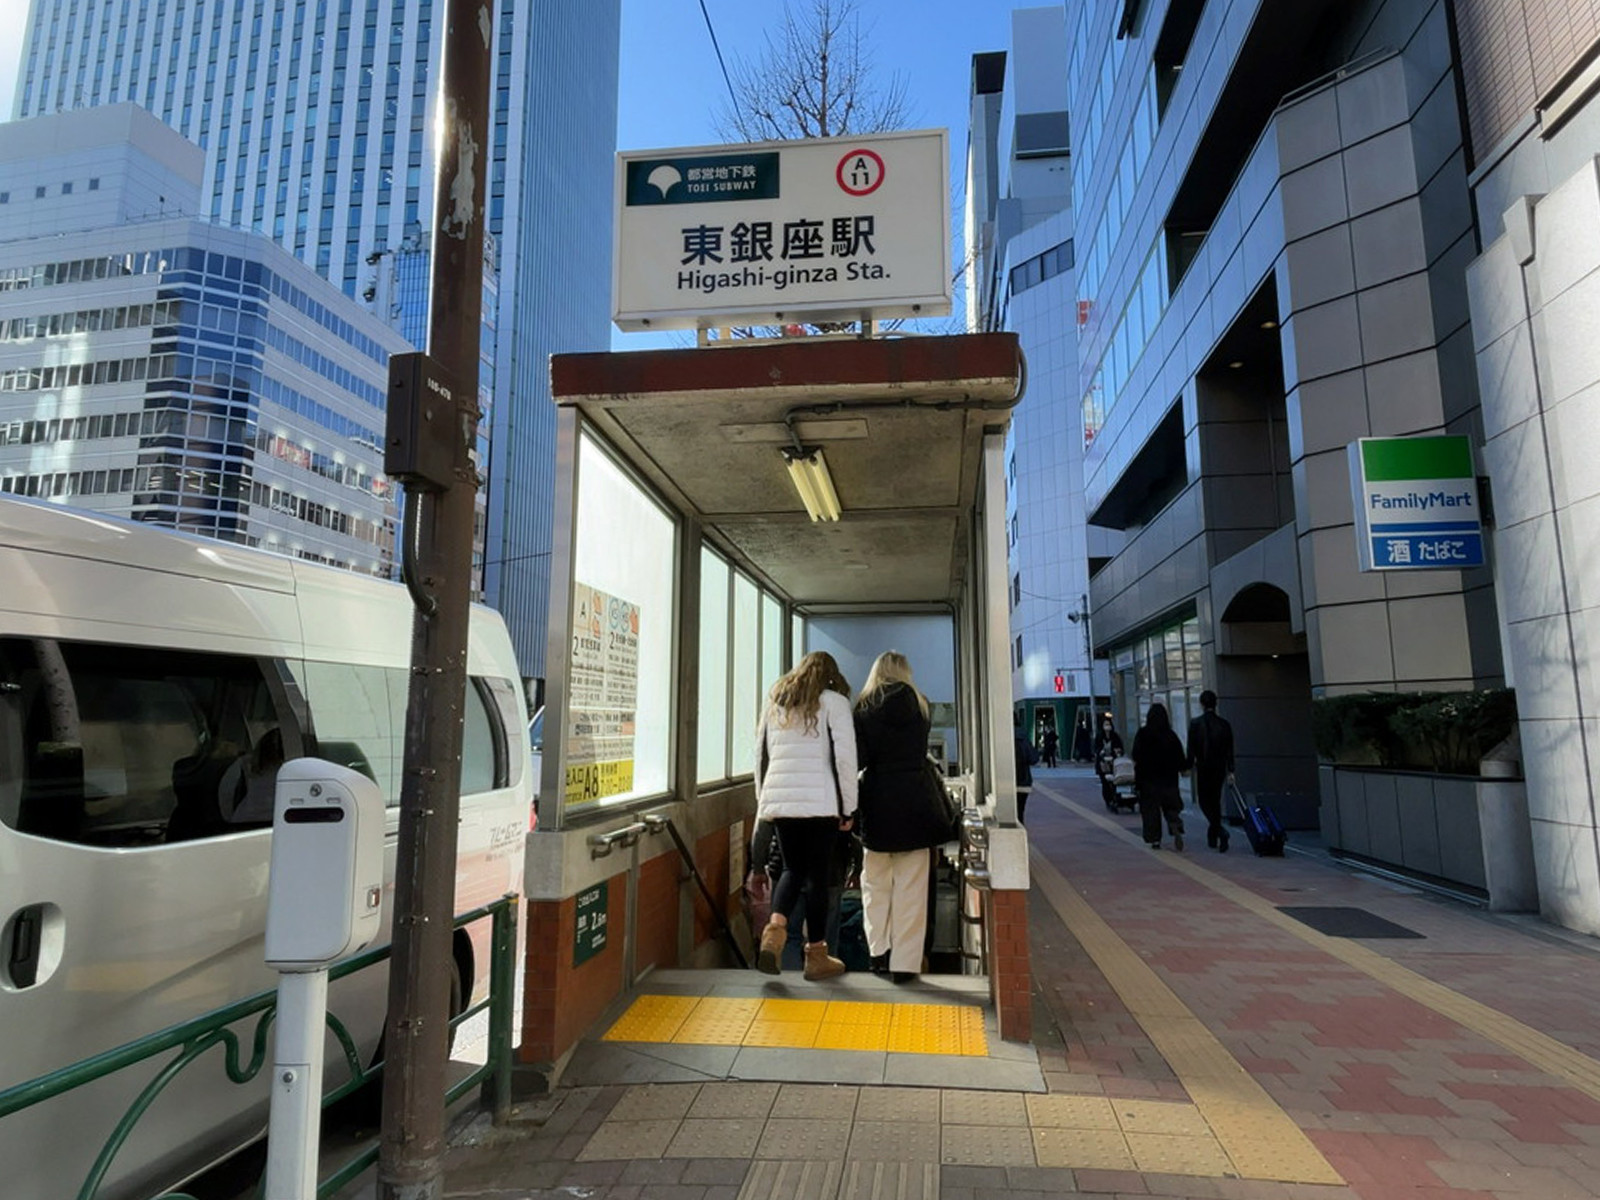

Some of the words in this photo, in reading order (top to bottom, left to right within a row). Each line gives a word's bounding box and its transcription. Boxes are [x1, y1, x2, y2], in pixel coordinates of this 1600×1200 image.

[855, 157, 867, 170] A
[687, 165, 757, 181] 都営地下鉄
[851, 171, 869, 186] 11
[687, 183, 710, 193] TOEI
[713, 180, 757, 193] SUBWAY
[681, 215, 876, 266] 東銀座駅
[677, 265, 838, 293] Higashi-ginza
[846, 261, 891, 281] Sta.
[1370, 491, 1472, 510] FamilyMart
[1387, 539, 1411, 563] 酒
[1418, 540, 1467, 561] たばこ
